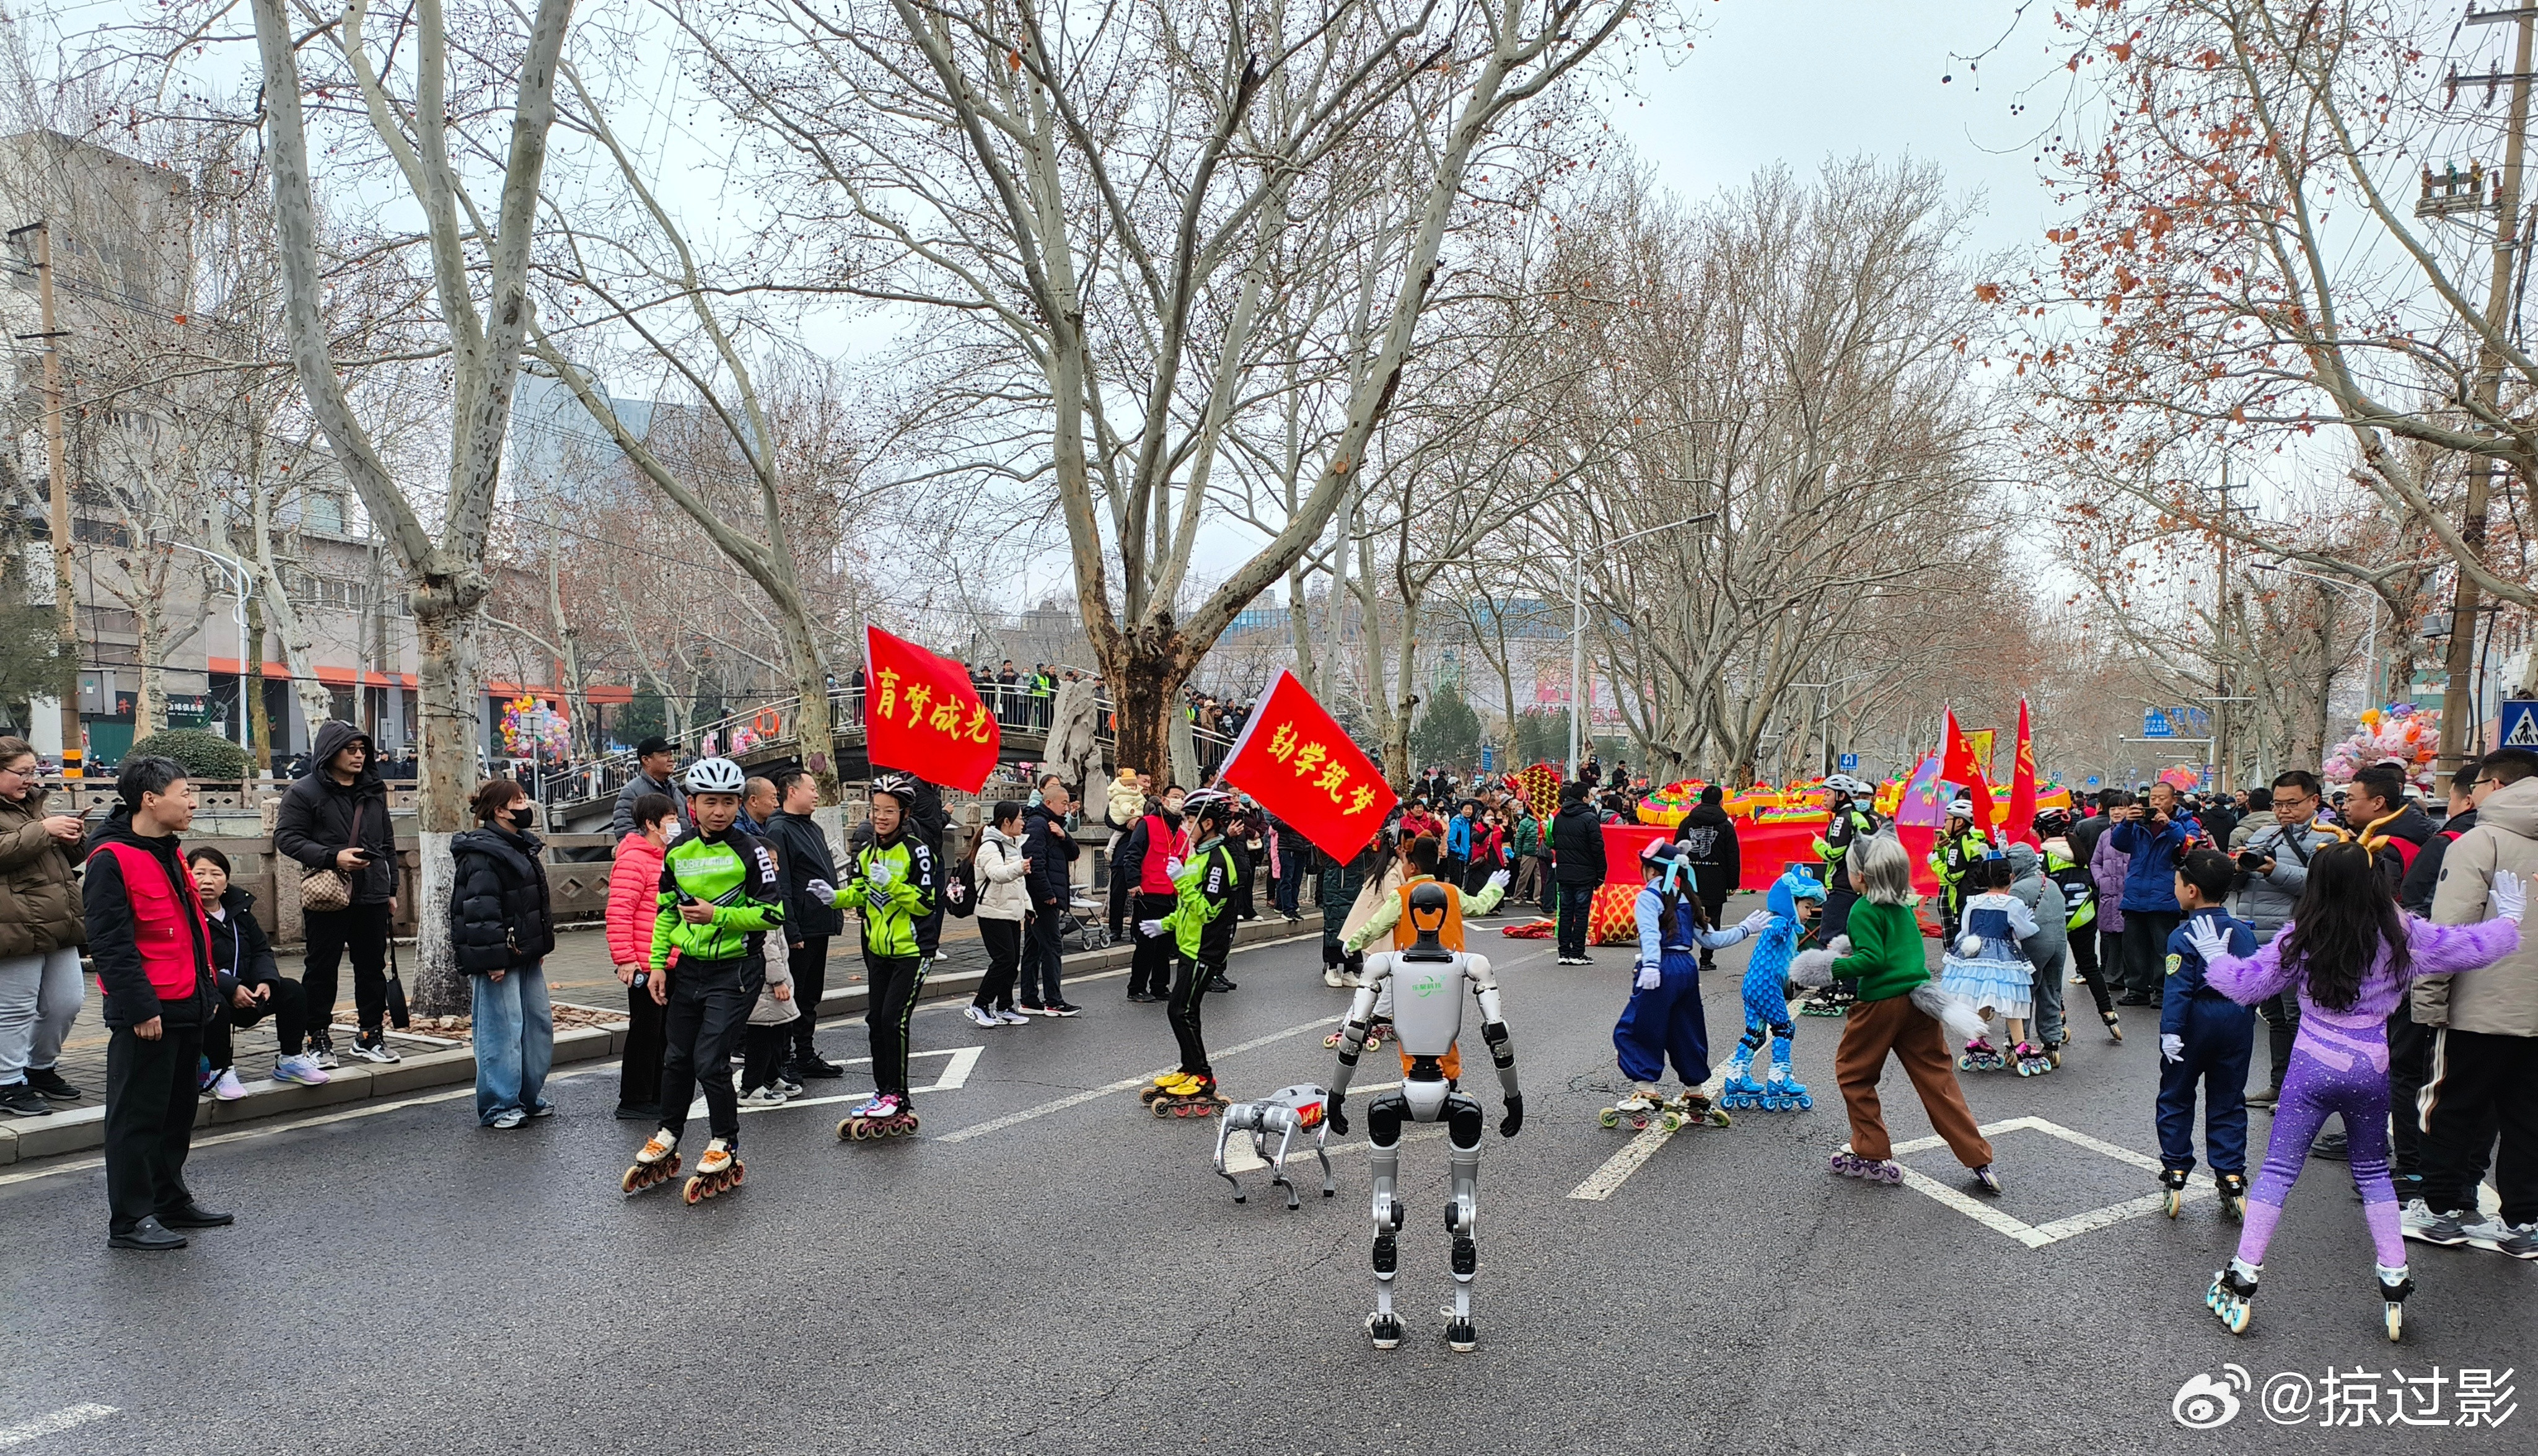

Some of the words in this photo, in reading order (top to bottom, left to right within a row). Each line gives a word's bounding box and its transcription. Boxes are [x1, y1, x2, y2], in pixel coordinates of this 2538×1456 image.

[876, 666, 991, 743] 育梦成光
[1267, 720, 1376, 816] 勤学筑梦
[1831, 816, 1845, 837] BOB
[754, 846, 776, 884] BOB
[1947, 848, 1959, 867] BOB
[1206, 866, 1223, 894] BOB
